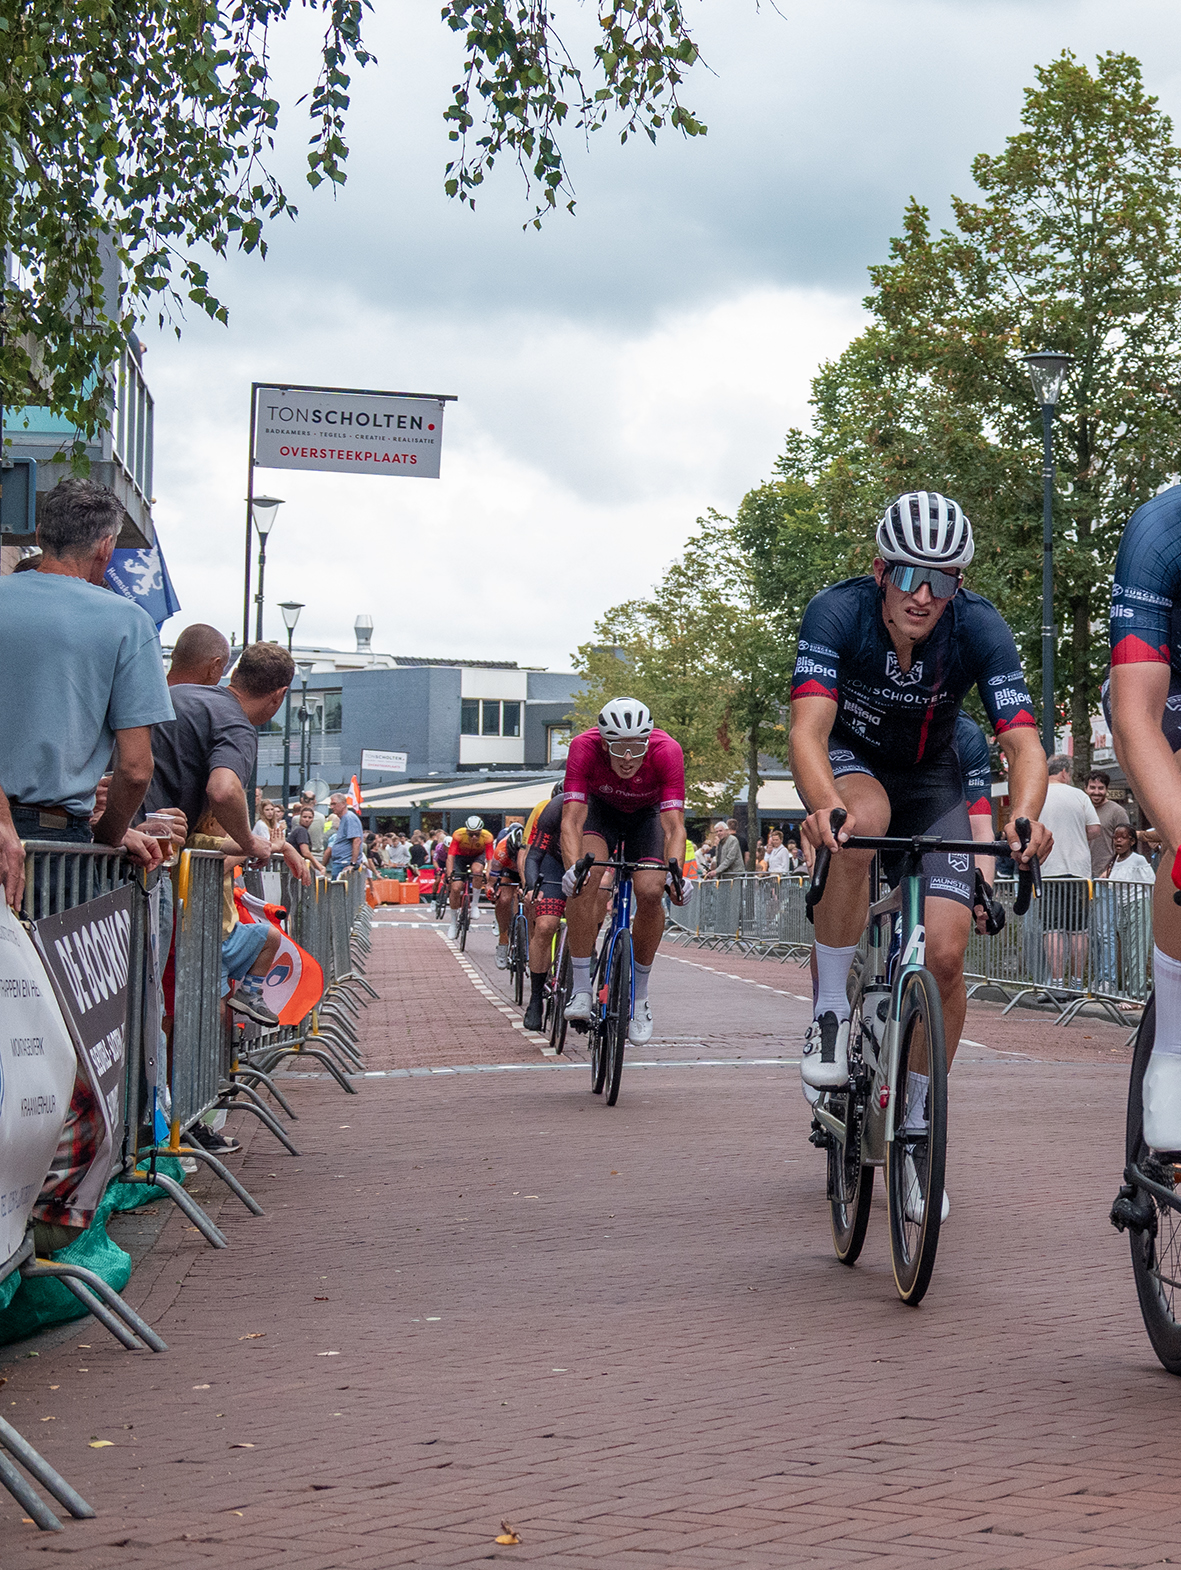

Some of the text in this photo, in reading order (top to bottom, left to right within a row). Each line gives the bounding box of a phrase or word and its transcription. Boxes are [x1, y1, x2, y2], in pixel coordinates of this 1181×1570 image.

[265, 428, 435, 445] BADKAMERS TEGELS CREATIE REALISATIE
[280, 446, 417, 465] OVERSTEEKPLAATS
[995, 688, 1017, 700] Blis
[54, 935, 93, 1014] DE
